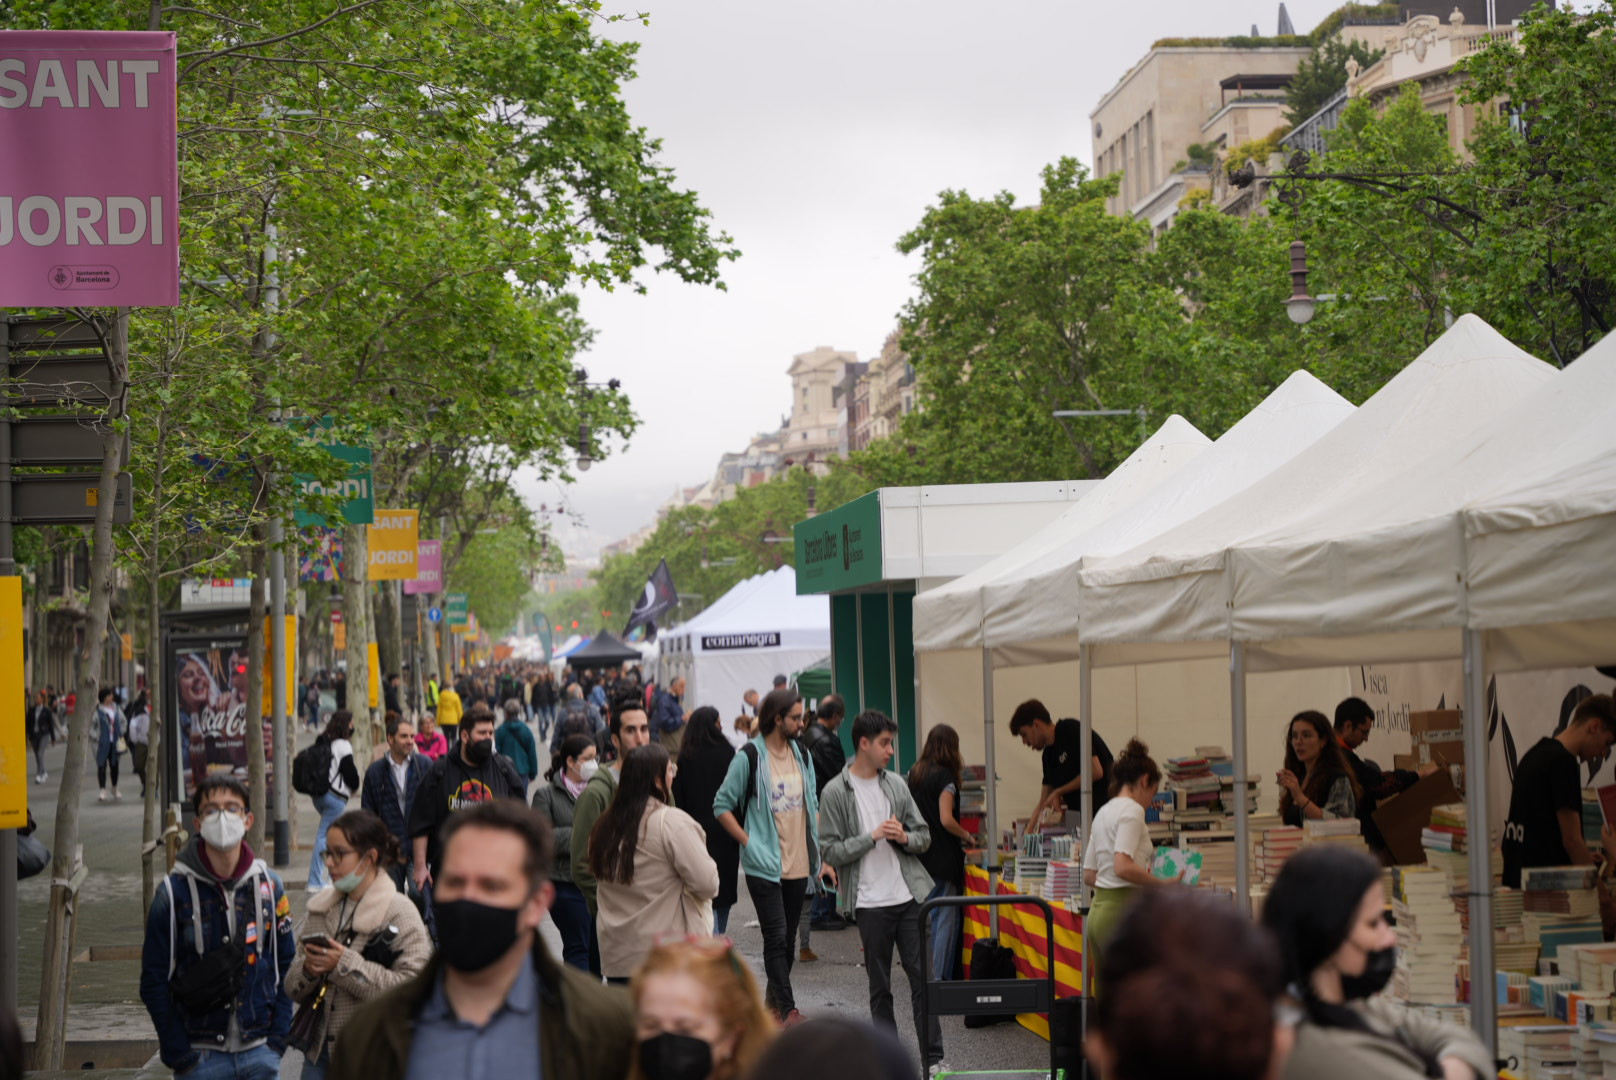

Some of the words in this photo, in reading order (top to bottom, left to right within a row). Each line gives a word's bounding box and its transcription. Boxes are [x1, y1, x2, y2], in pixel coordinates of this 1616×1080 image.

[0, 58, 160, 109] SANT
[0, 195, 164, 247] JORDI
[371, 516, 412, 529] SANT
[369, 550, 414, 565] JORDI
